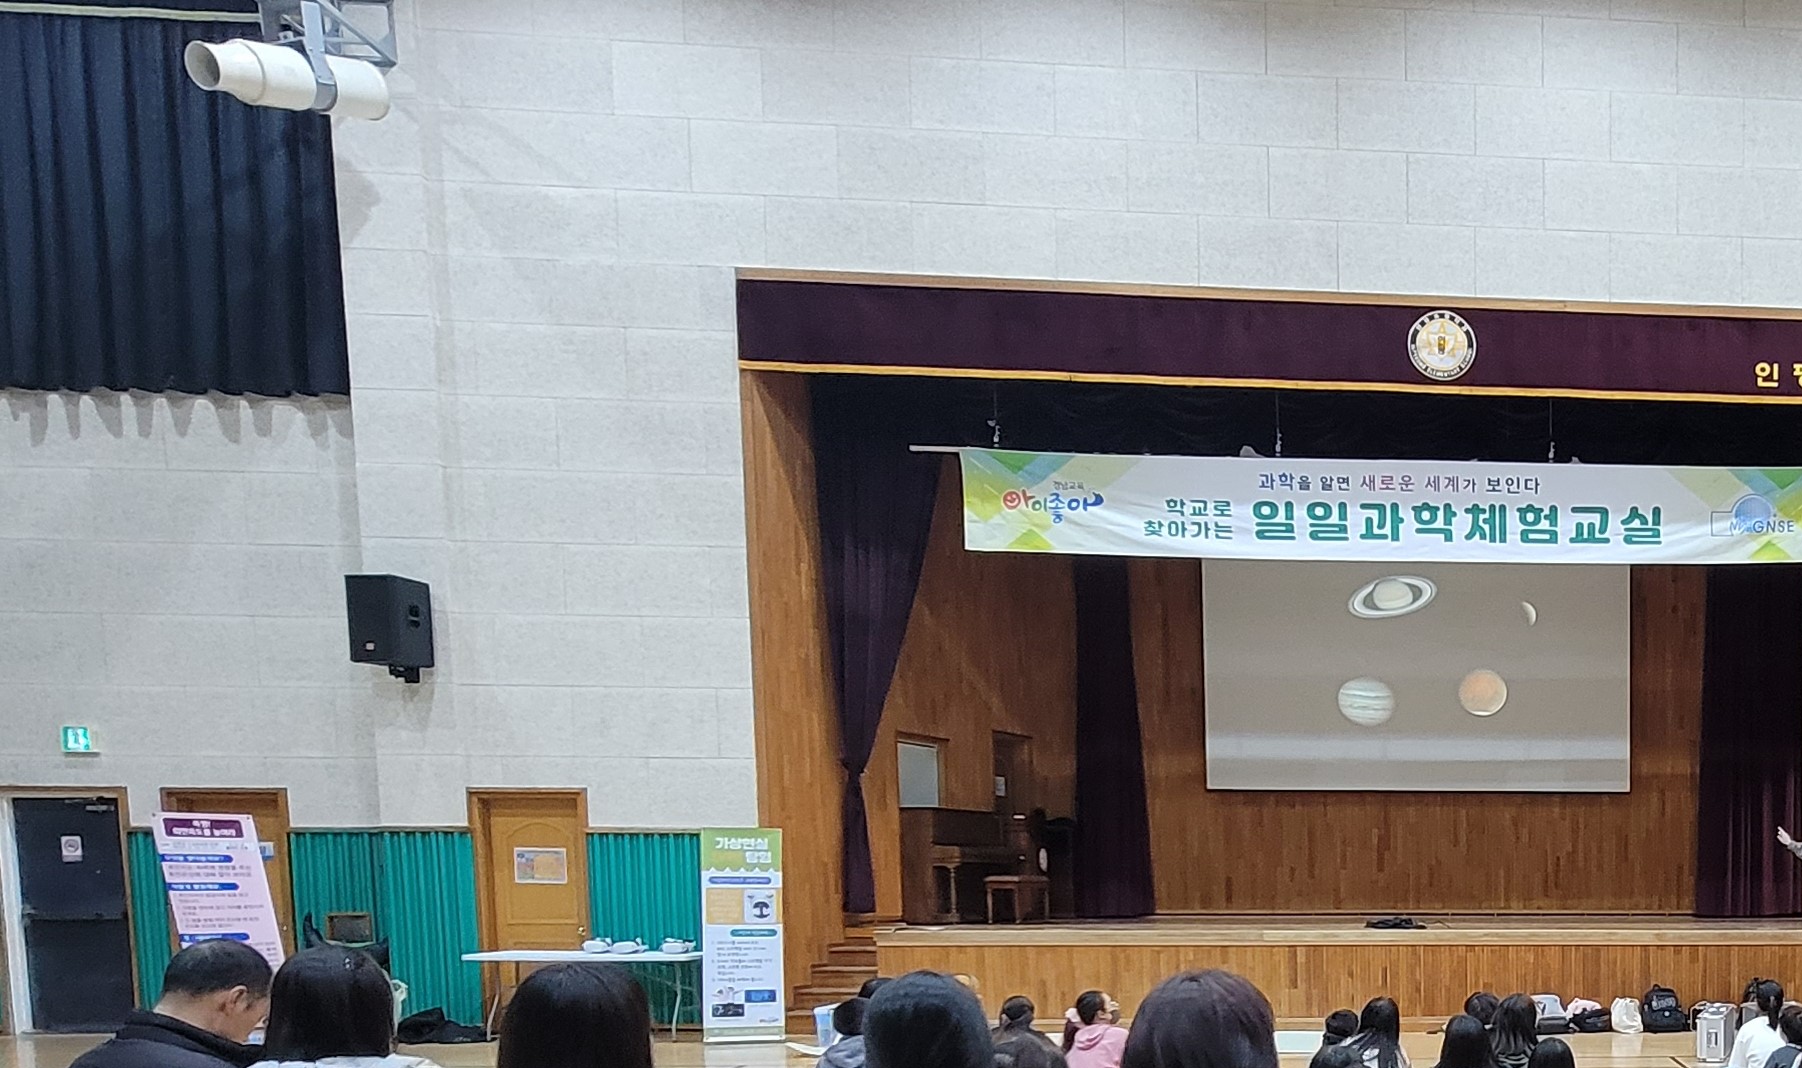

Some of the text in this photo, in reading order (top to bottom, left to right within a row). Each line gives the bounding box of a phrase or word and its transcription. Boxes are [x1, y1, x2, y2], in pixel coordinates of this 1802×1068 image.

[1258, 472, 1541, 495] 과학을 알면 새로운 세계가 보인다
[1165, 498, 1233, 518] 학교로
[1143, 520, 1234, 540] 찾아가는
[1252, 500, 1663, 545] 일일과학체험교실
[1752, 519, 1795, 534] GNSE
